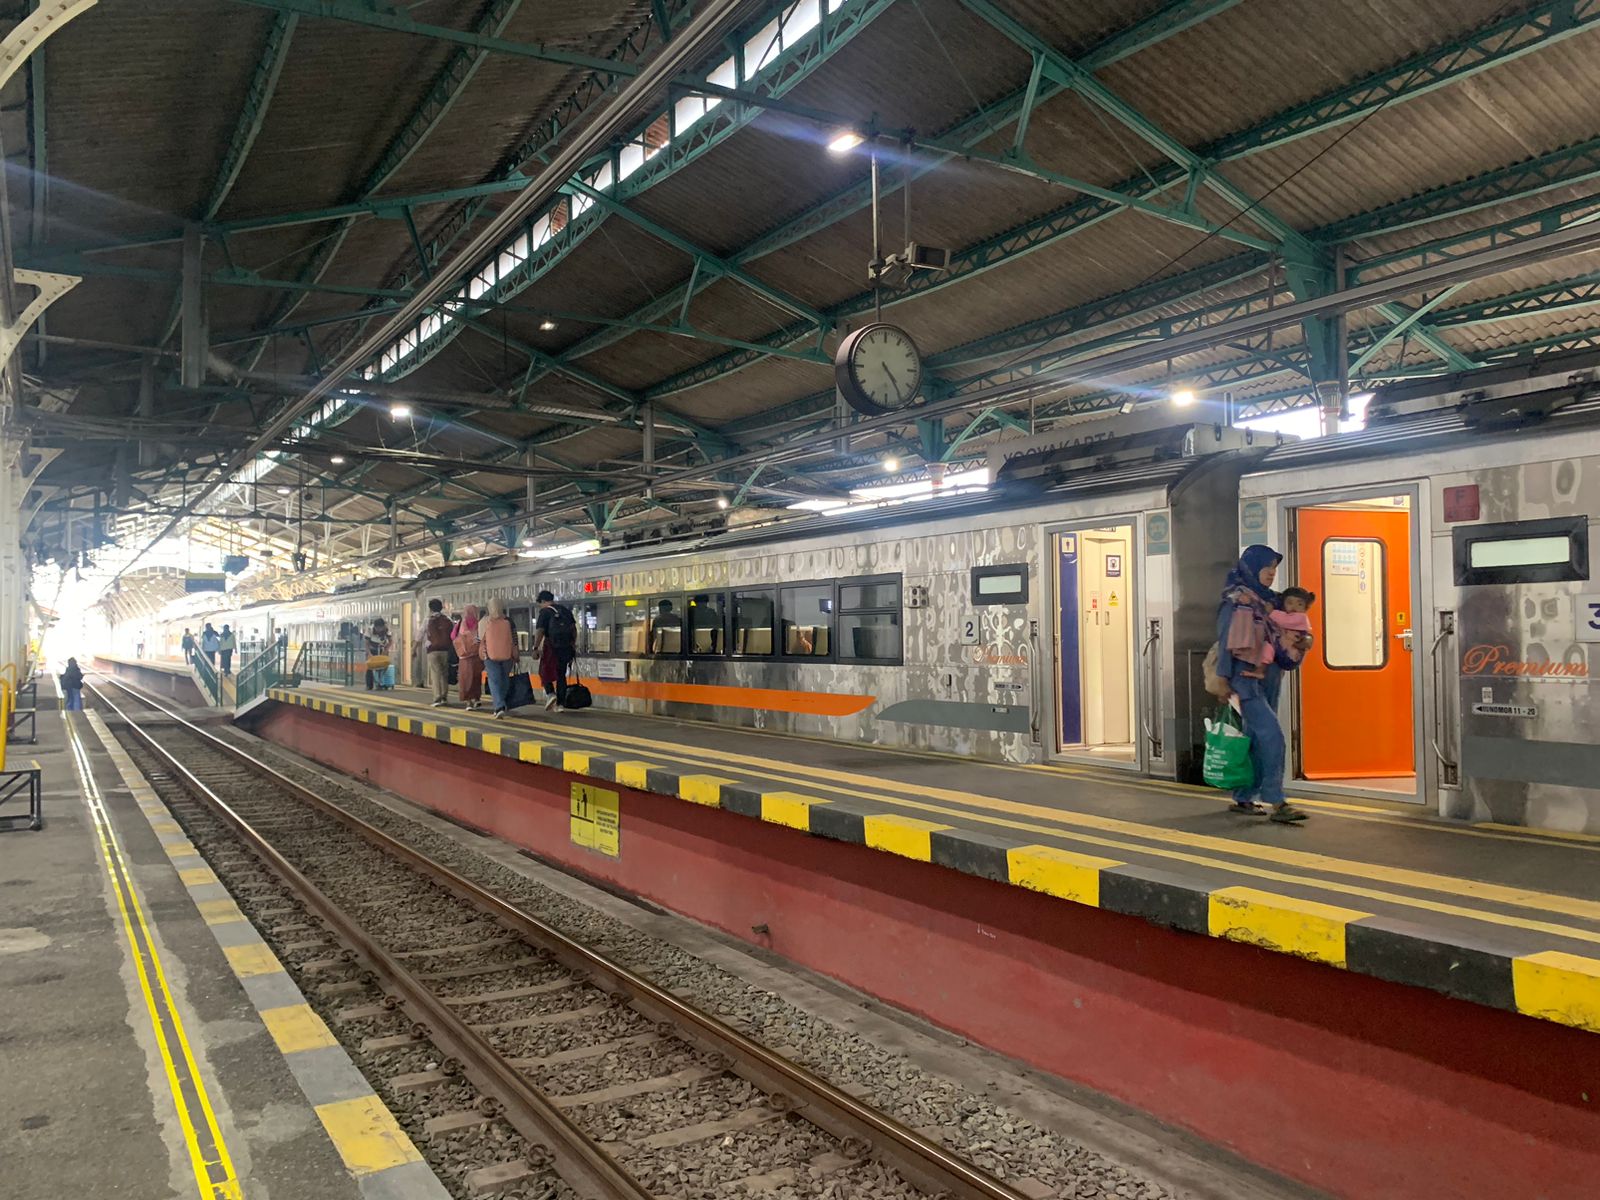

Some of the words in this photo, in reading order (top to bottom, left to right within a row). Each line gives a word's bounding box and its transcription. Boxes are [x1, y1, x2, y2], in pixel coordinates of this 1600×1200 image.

[965, 621, 974, 637] 2
[1588, 603, 1600, 630] 3
[1462, 644, 1590, 677] Premium
